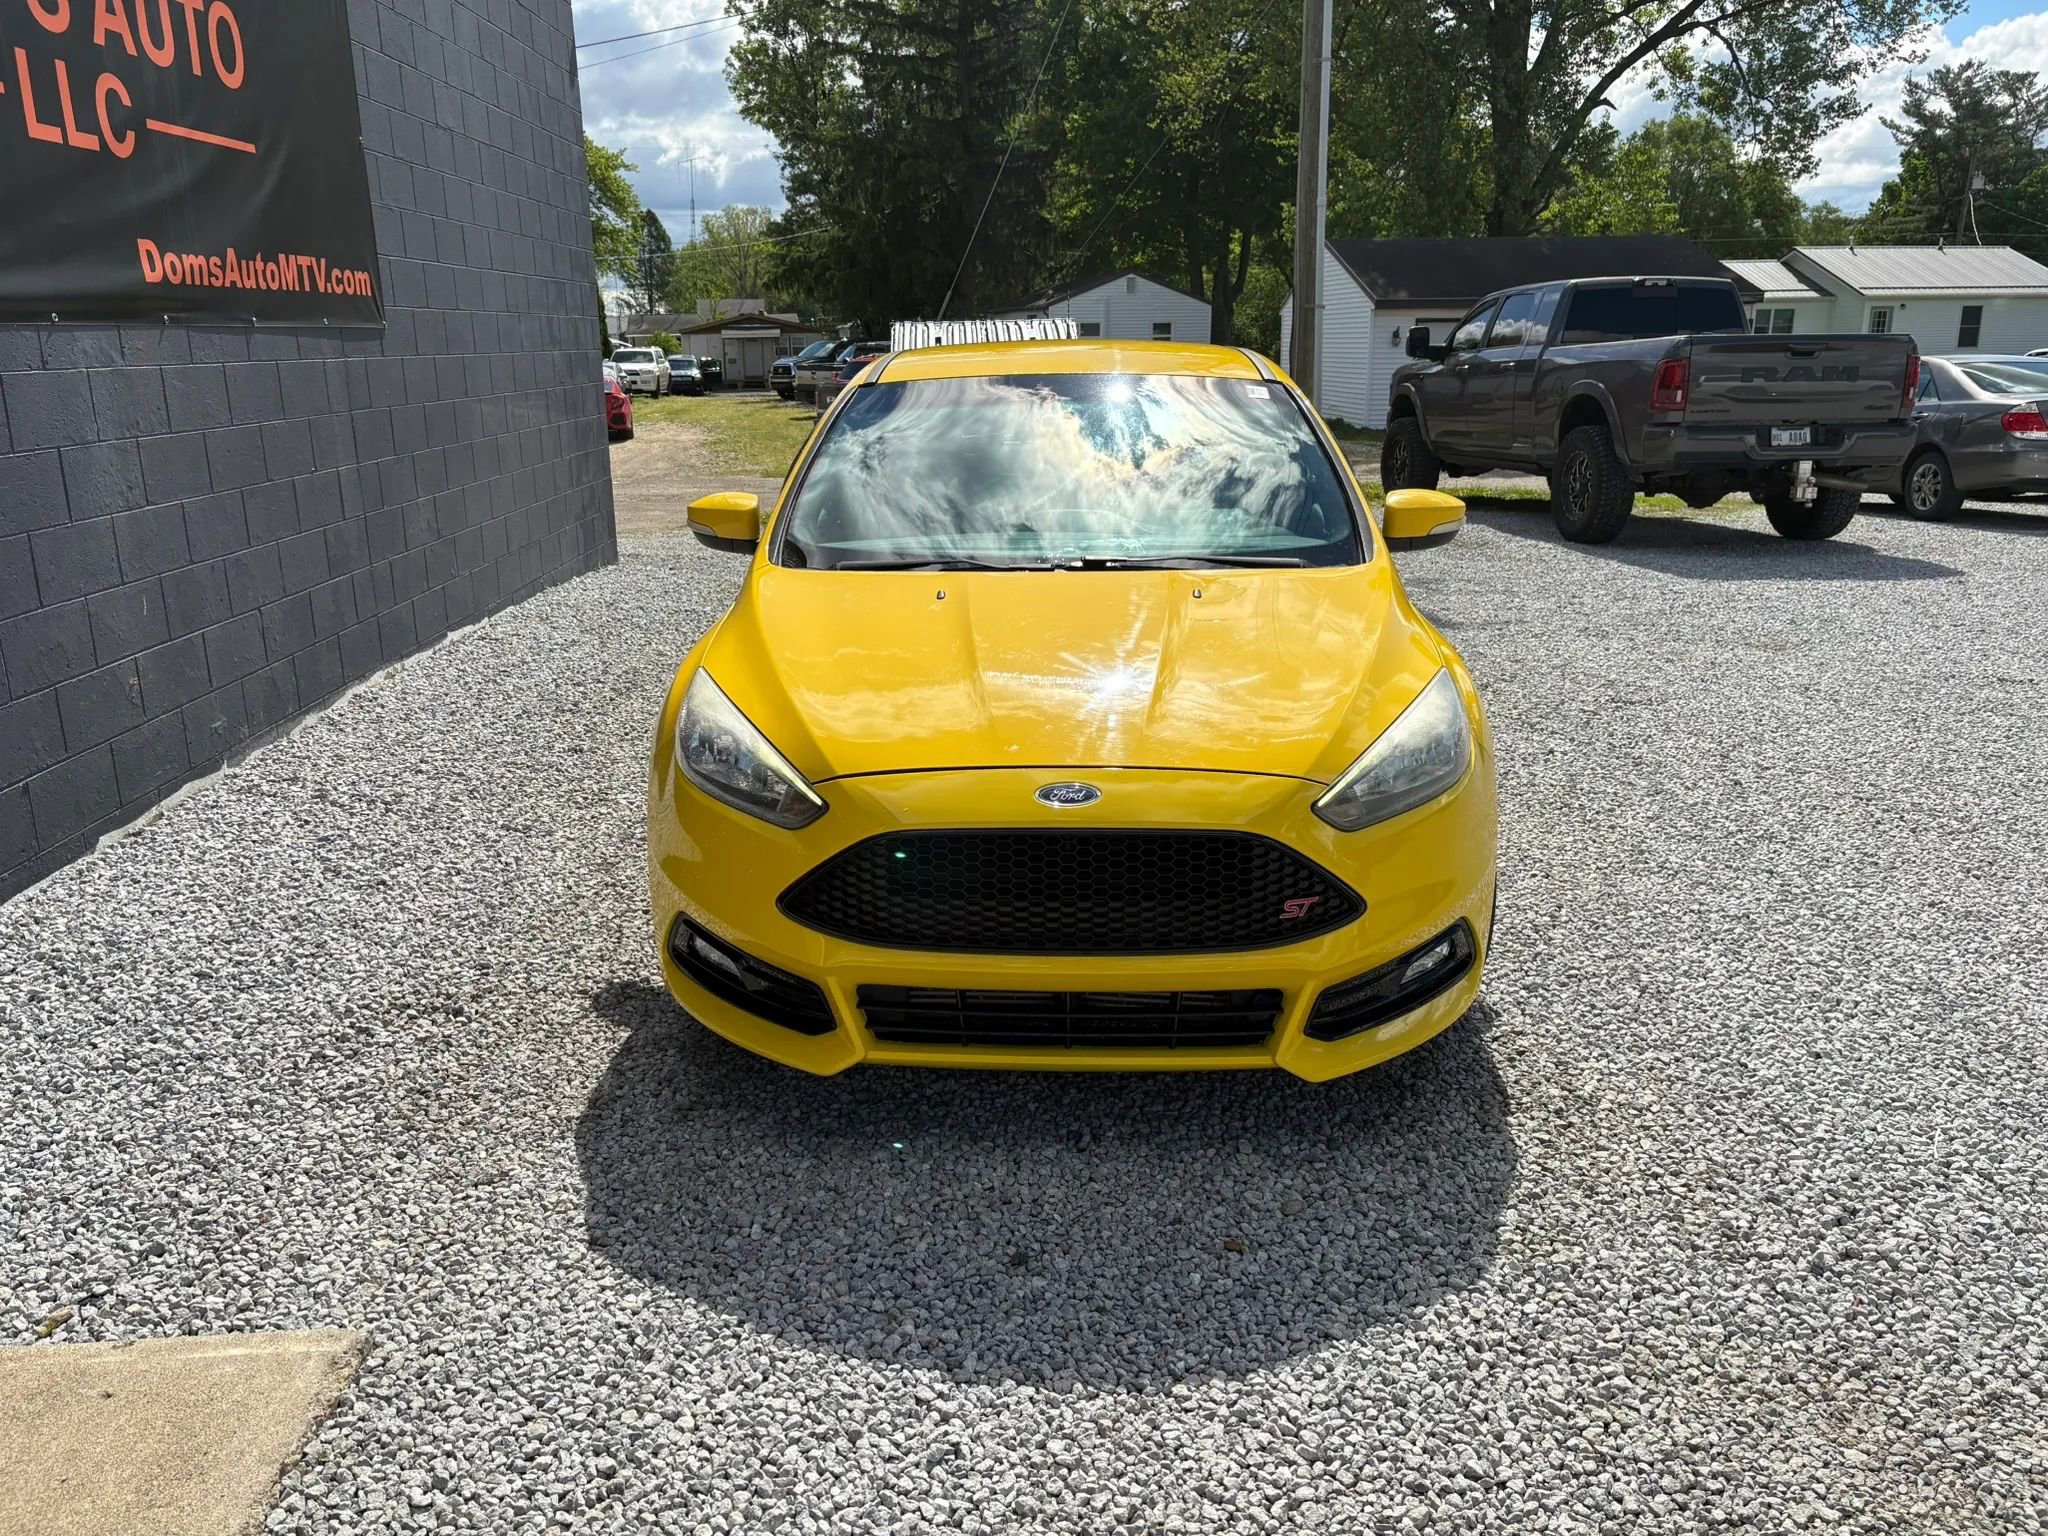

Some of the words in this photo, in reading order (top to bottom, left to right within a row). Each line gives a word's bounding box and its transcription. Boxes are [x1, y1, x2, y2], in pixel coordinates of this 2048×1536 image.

[93, 0, 245, 89] AUTO
[14, 46, 136, 159] LLC
[137, 238, 372, 296] DomsAutoMTV.com
[1740, 366, 1860, 383] RAM
[1049, 788, 1087, 801] Ford
[1279, 896, 1320, 919] ST
